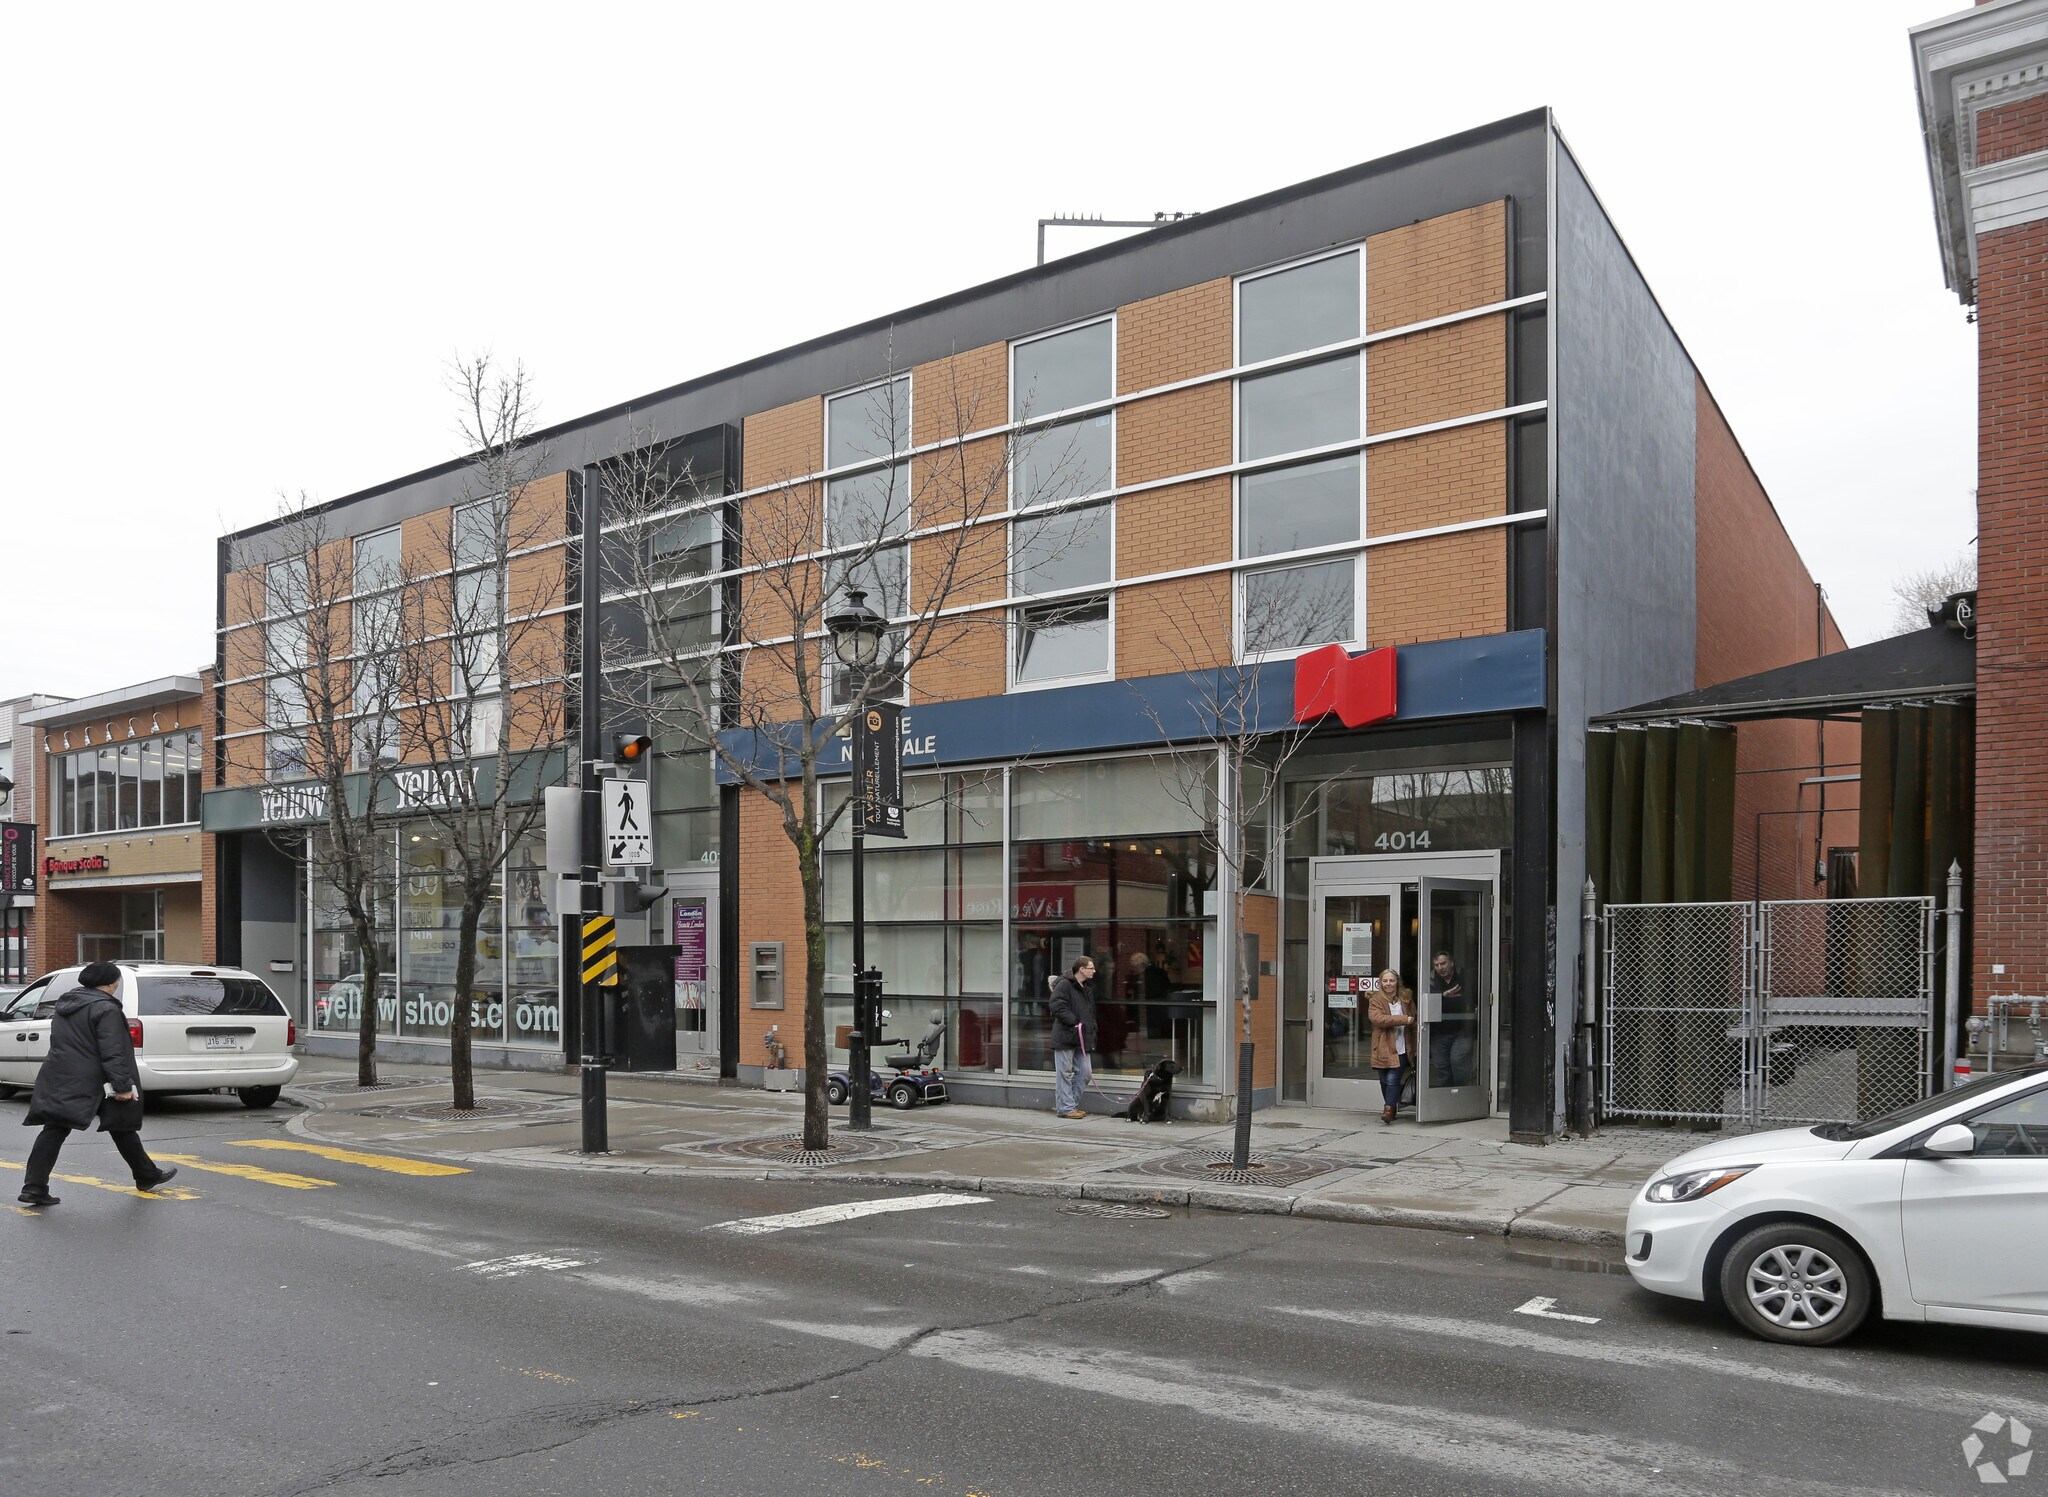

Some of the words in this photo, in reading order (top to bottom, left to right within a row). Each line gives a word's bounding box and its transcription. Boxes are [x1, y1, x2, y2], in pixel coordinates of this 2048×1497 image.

[395, 767, 479, 808] Yellow
[259, 786, 327, 822] Yellow
[1374, 830, 1432, 850] 4014
[49, 859, 78, 873] Banque
[79, 856, 102, 869] Scotia
[409, 911, 432, 924] DEPUIS
[680, 909, 702, 917] London
